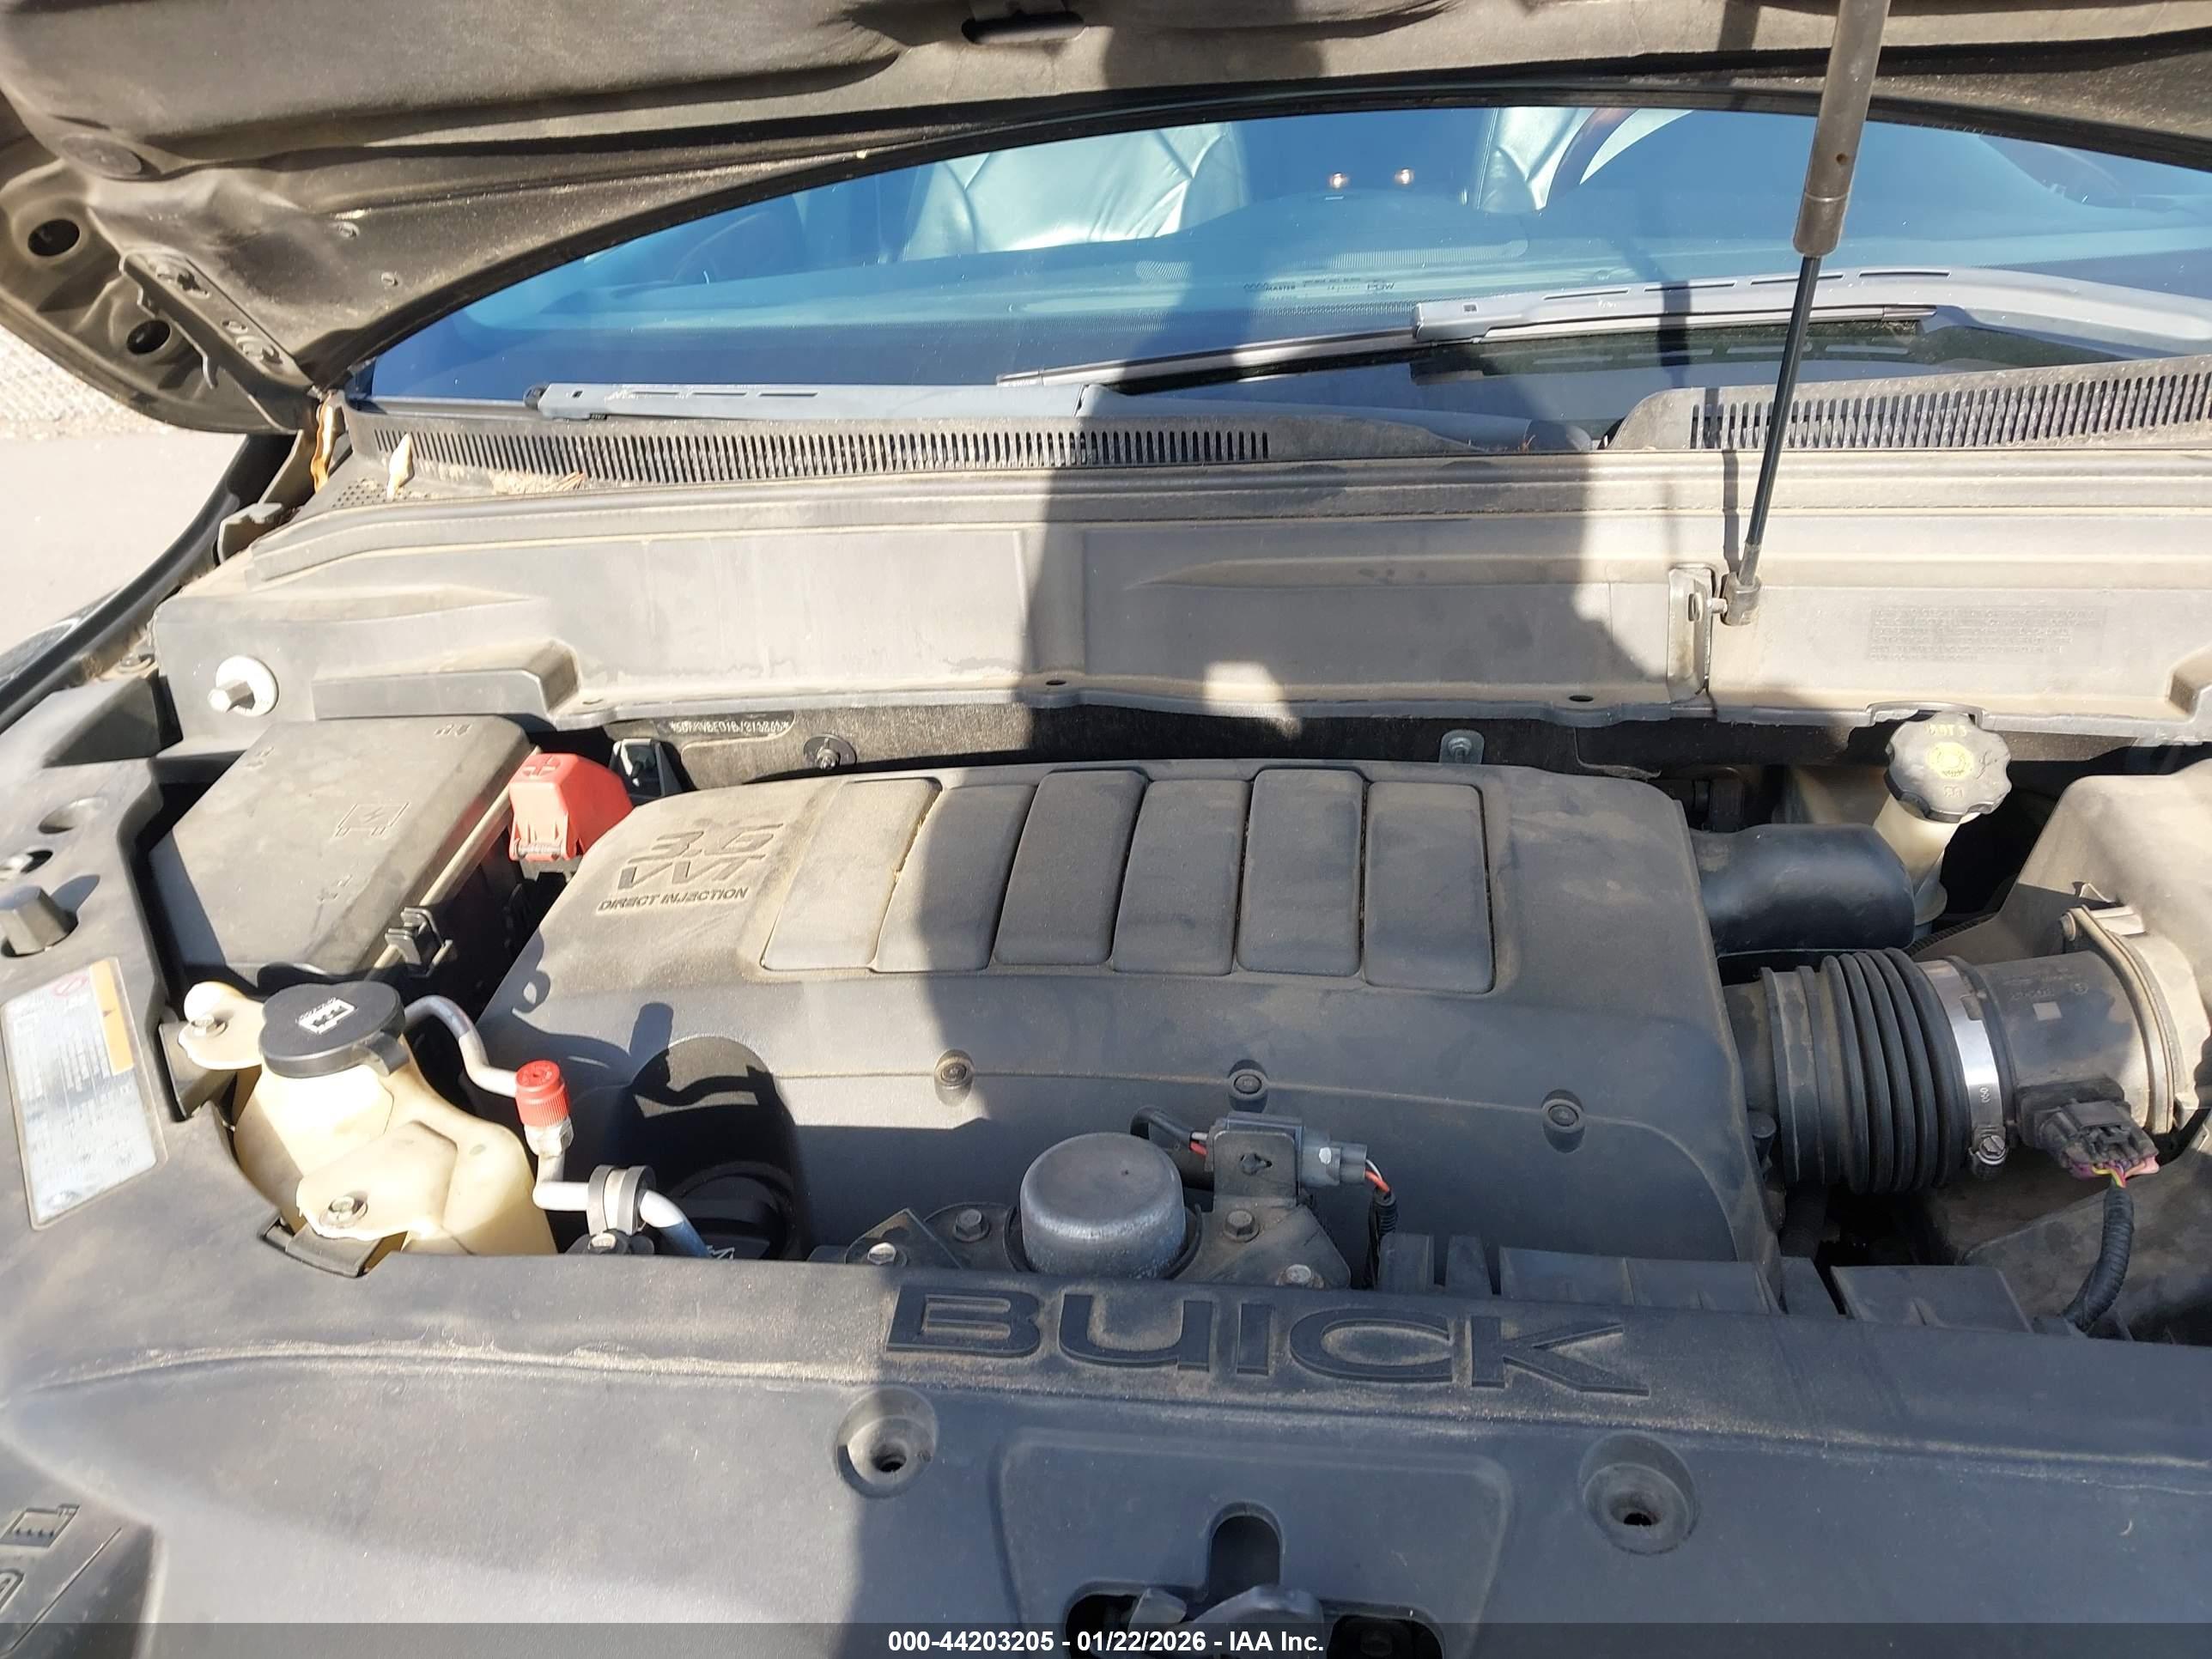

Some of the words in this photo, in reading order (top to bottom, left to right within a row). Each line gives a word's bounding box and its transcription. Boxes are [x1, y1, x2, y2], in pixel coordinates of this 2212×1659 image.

[597, 893, 660, 912] DIRECT
[660, 886, 750, 905] INJECTION
[884, 1284, 1650, 1396] BUICK
